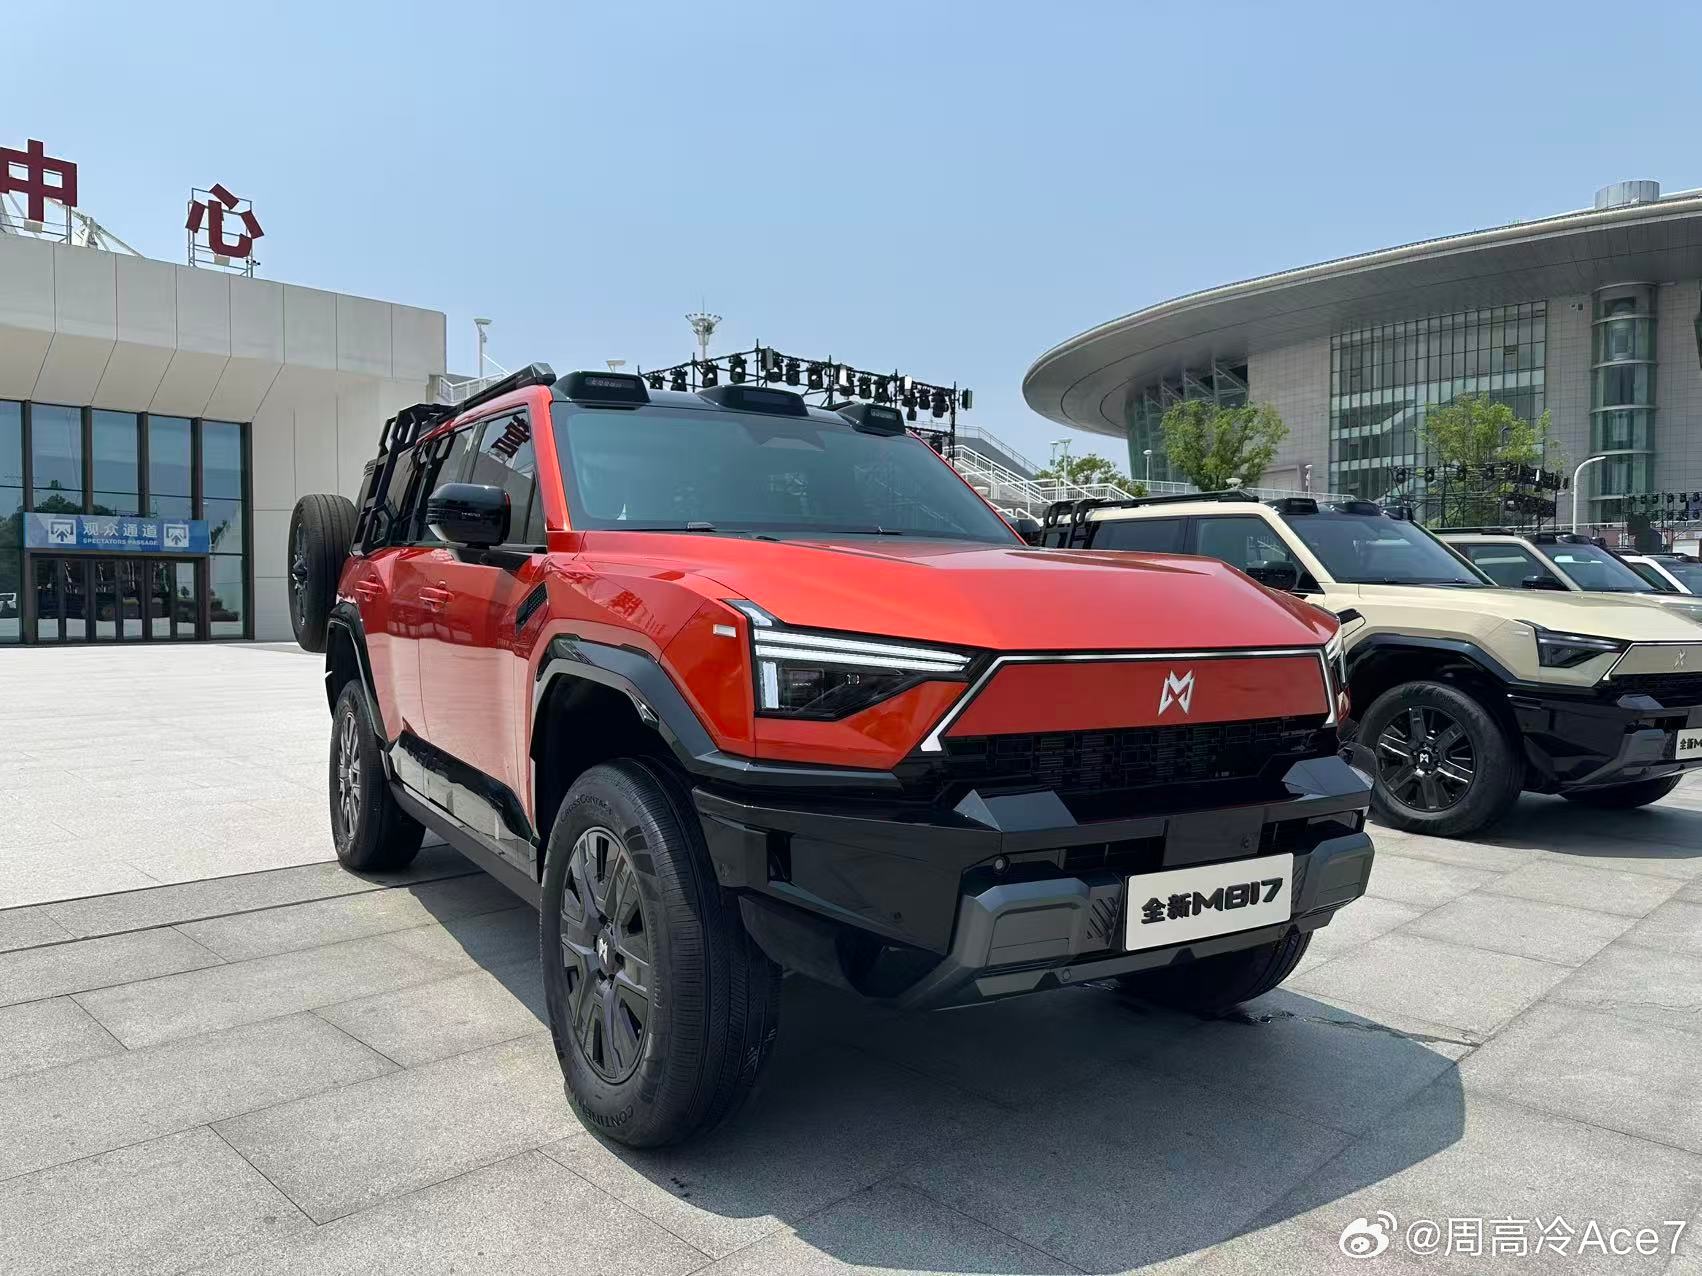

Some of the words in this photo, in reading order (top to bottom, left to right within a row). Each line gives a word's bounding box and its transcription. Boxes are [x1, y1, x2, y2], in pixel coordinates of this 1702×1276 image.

[0, 139, 264, 257] 中心
[83, 522, 157, 538] 观众通道
[1680, 738, 1702, 750] 全新M
